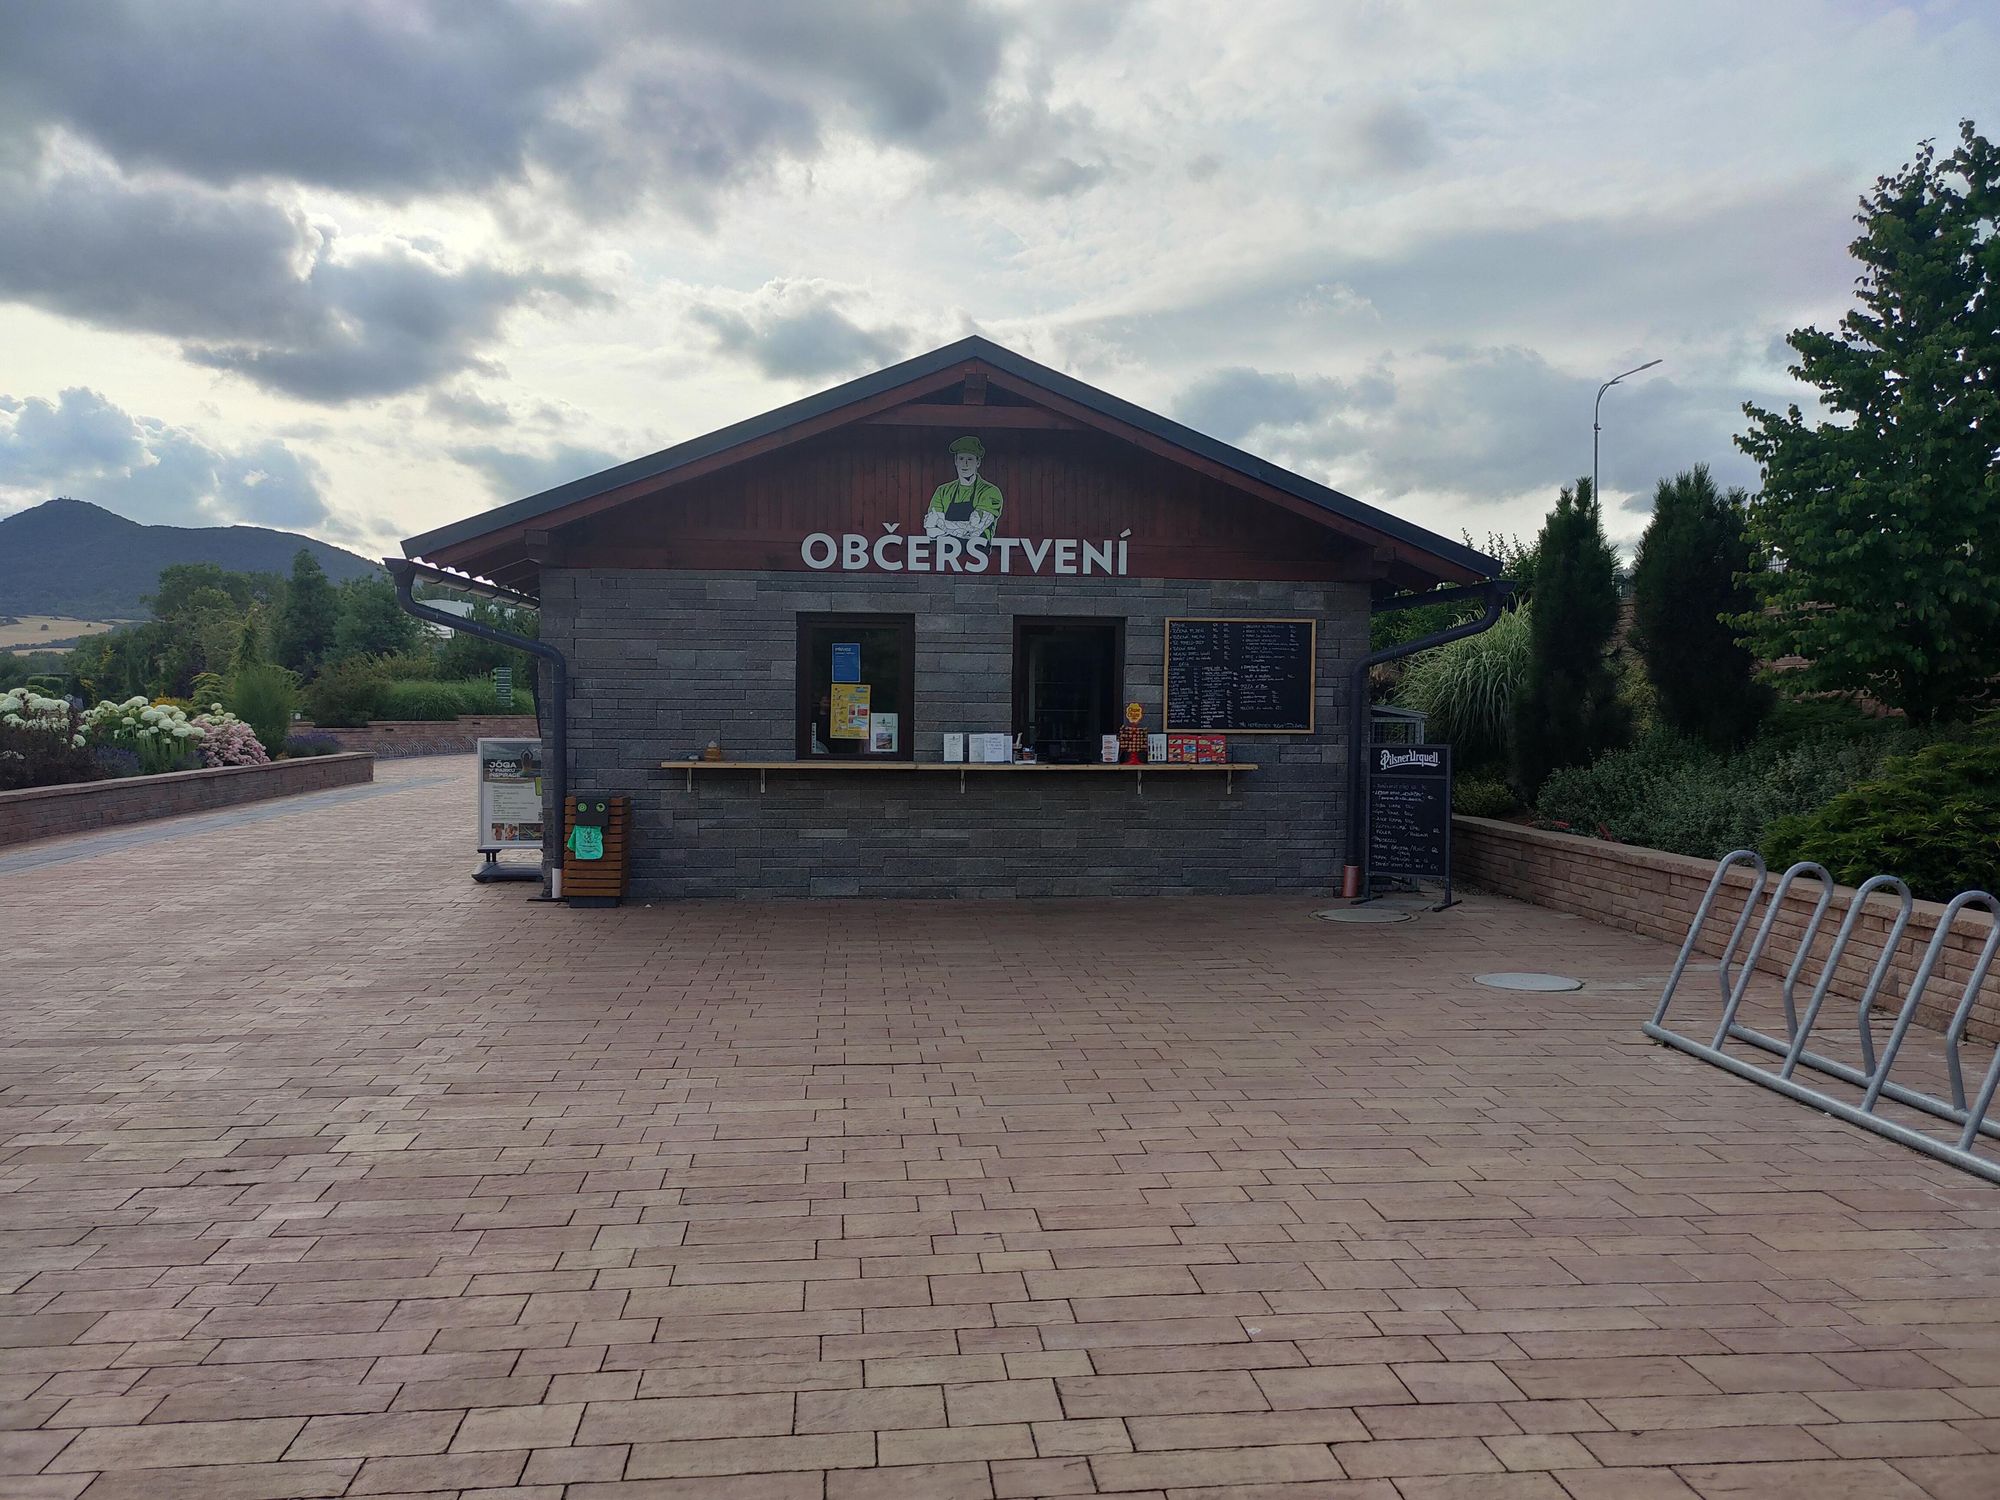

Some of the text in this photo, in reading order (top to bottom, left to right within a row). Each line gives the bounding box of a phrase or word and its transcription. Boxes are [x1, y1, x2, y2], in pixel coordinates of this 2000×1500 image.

[800, 523, 1132, 575] OBČERSTVENÍ
[489, 760, 517, 768] JÓGA
[1380, 749, 1409, 770] Pilsner
